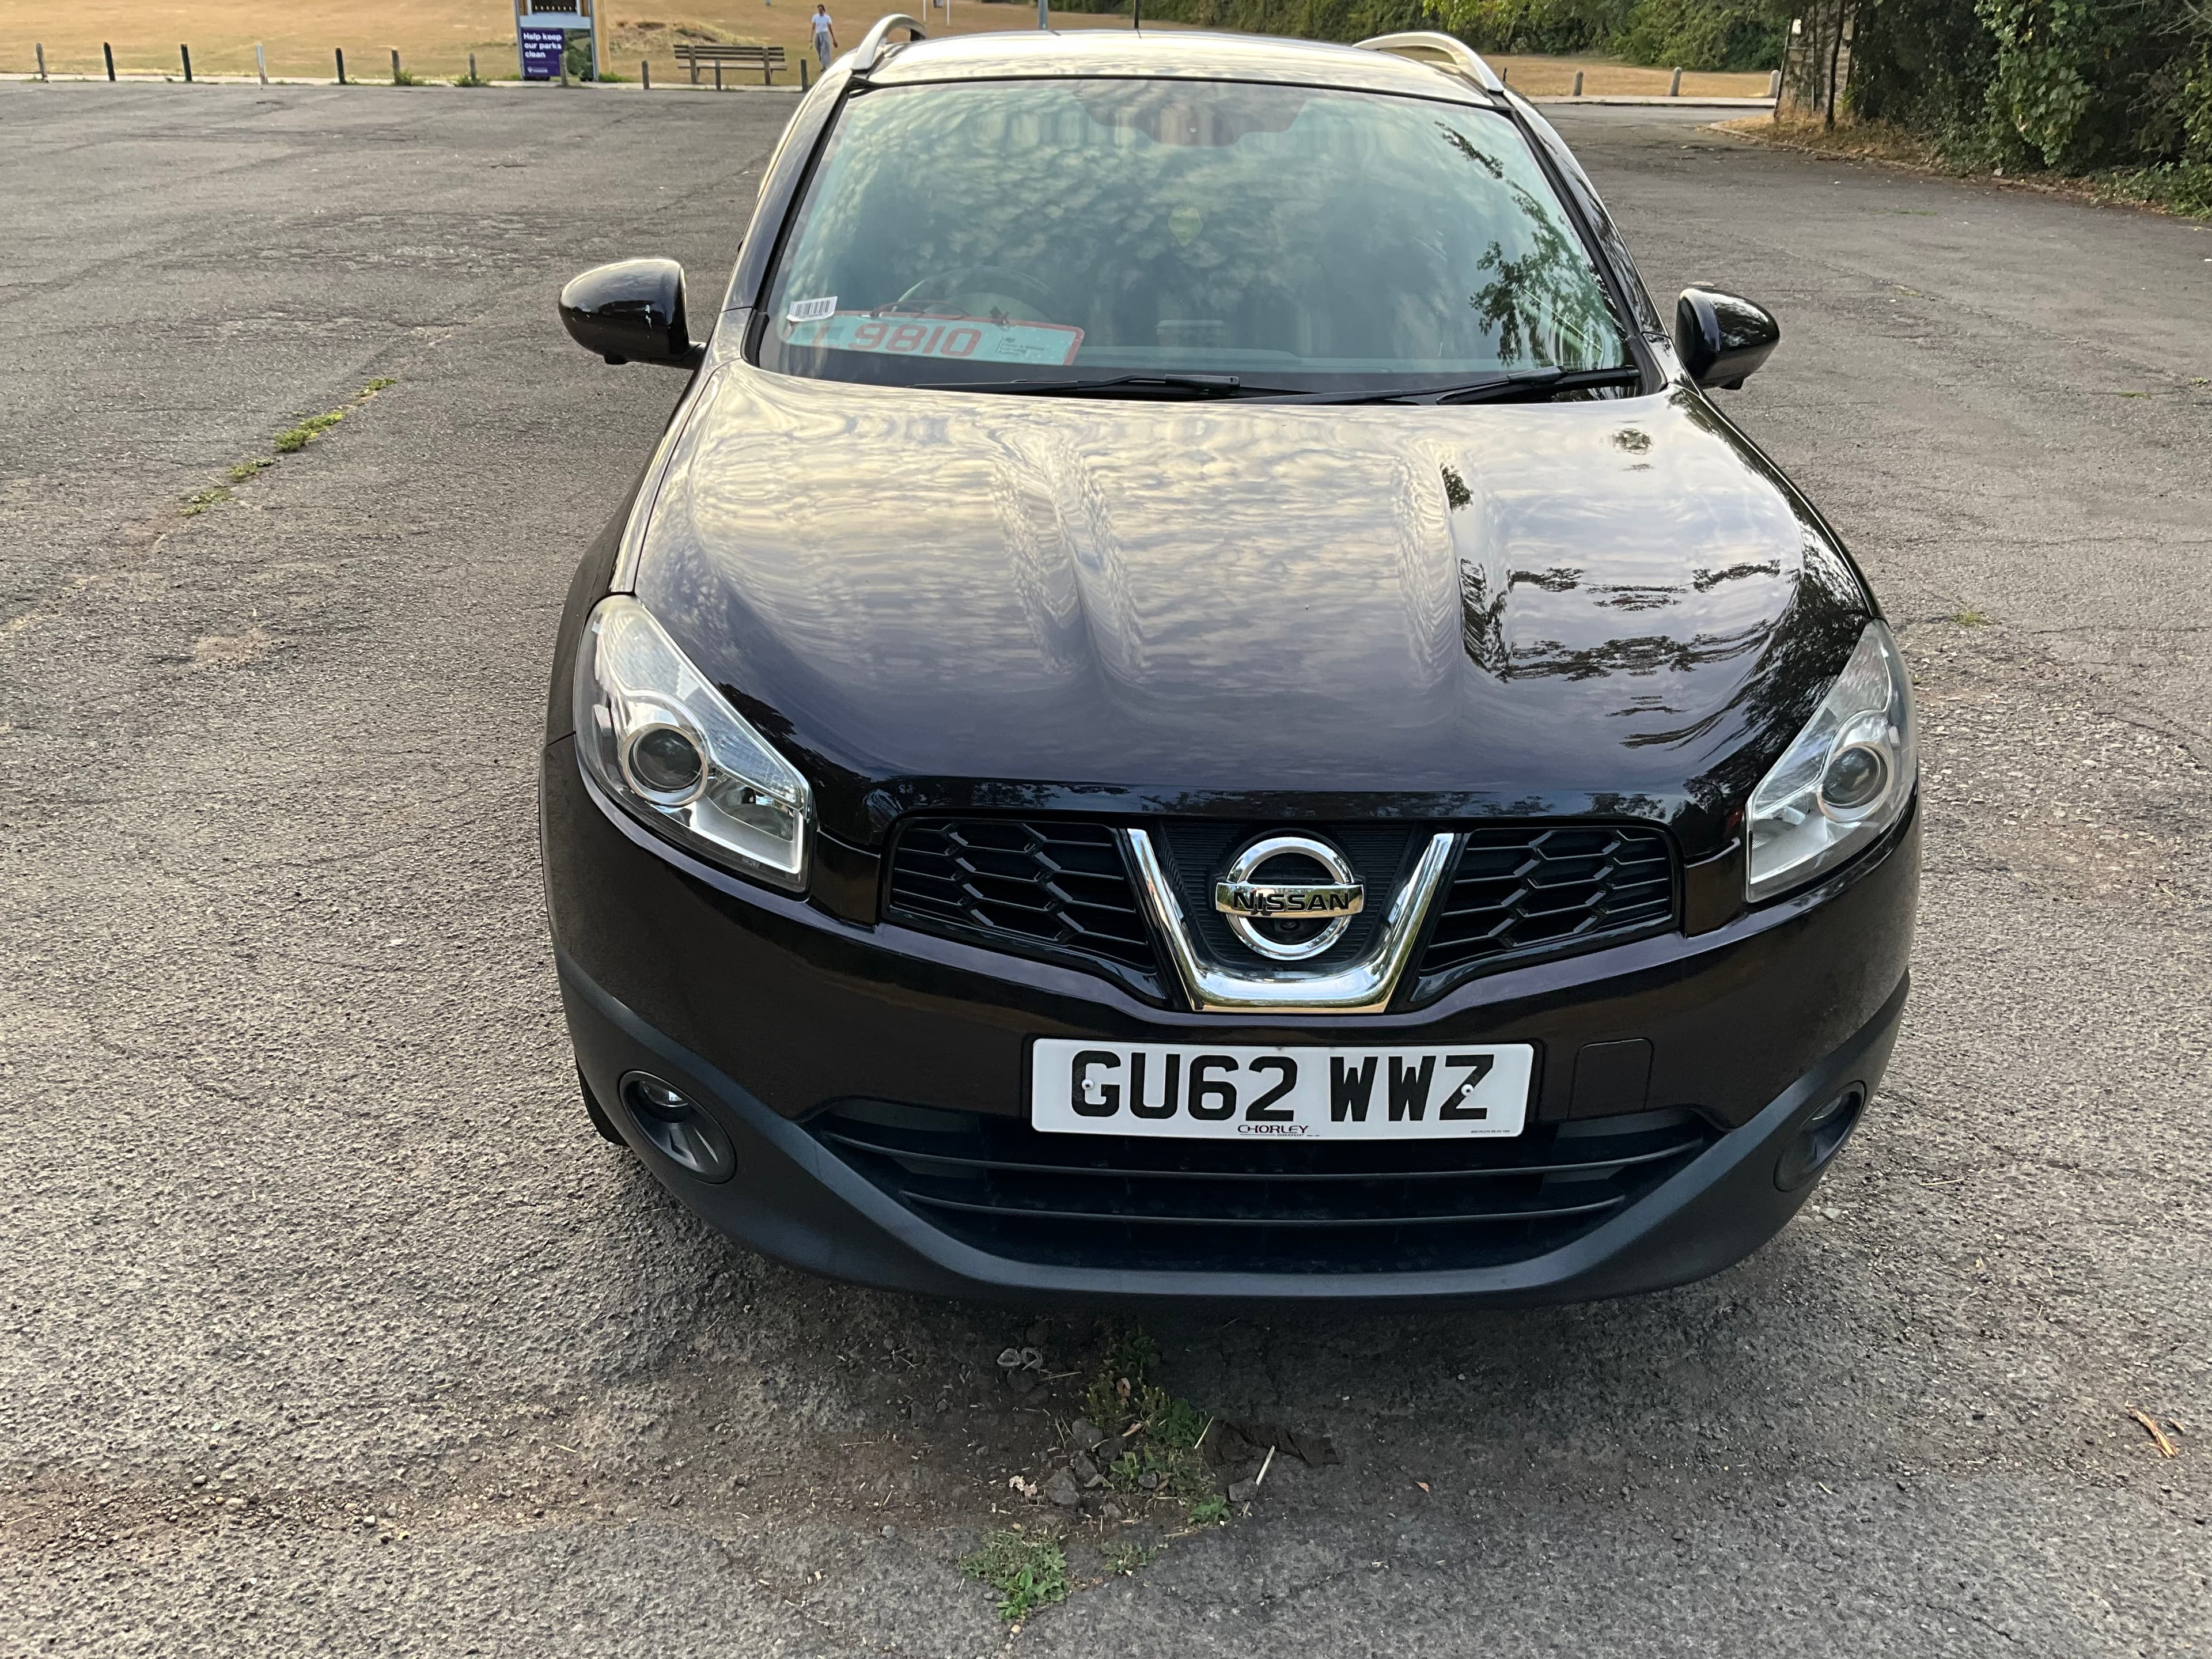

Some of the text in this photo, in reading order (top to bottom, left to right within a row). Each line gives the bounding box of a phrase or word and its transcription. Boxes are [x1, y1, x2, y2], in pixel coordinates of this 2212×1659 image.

[524, 32, 562, 41] Help keep
[539, 42, 562, 50] parks
[1233, 892, 1349, 911] NISSAN
[1071, 1050, 1494, 1122] GU62 WWZ
[1237, 1124, 1309, 1134] CHORLEY
